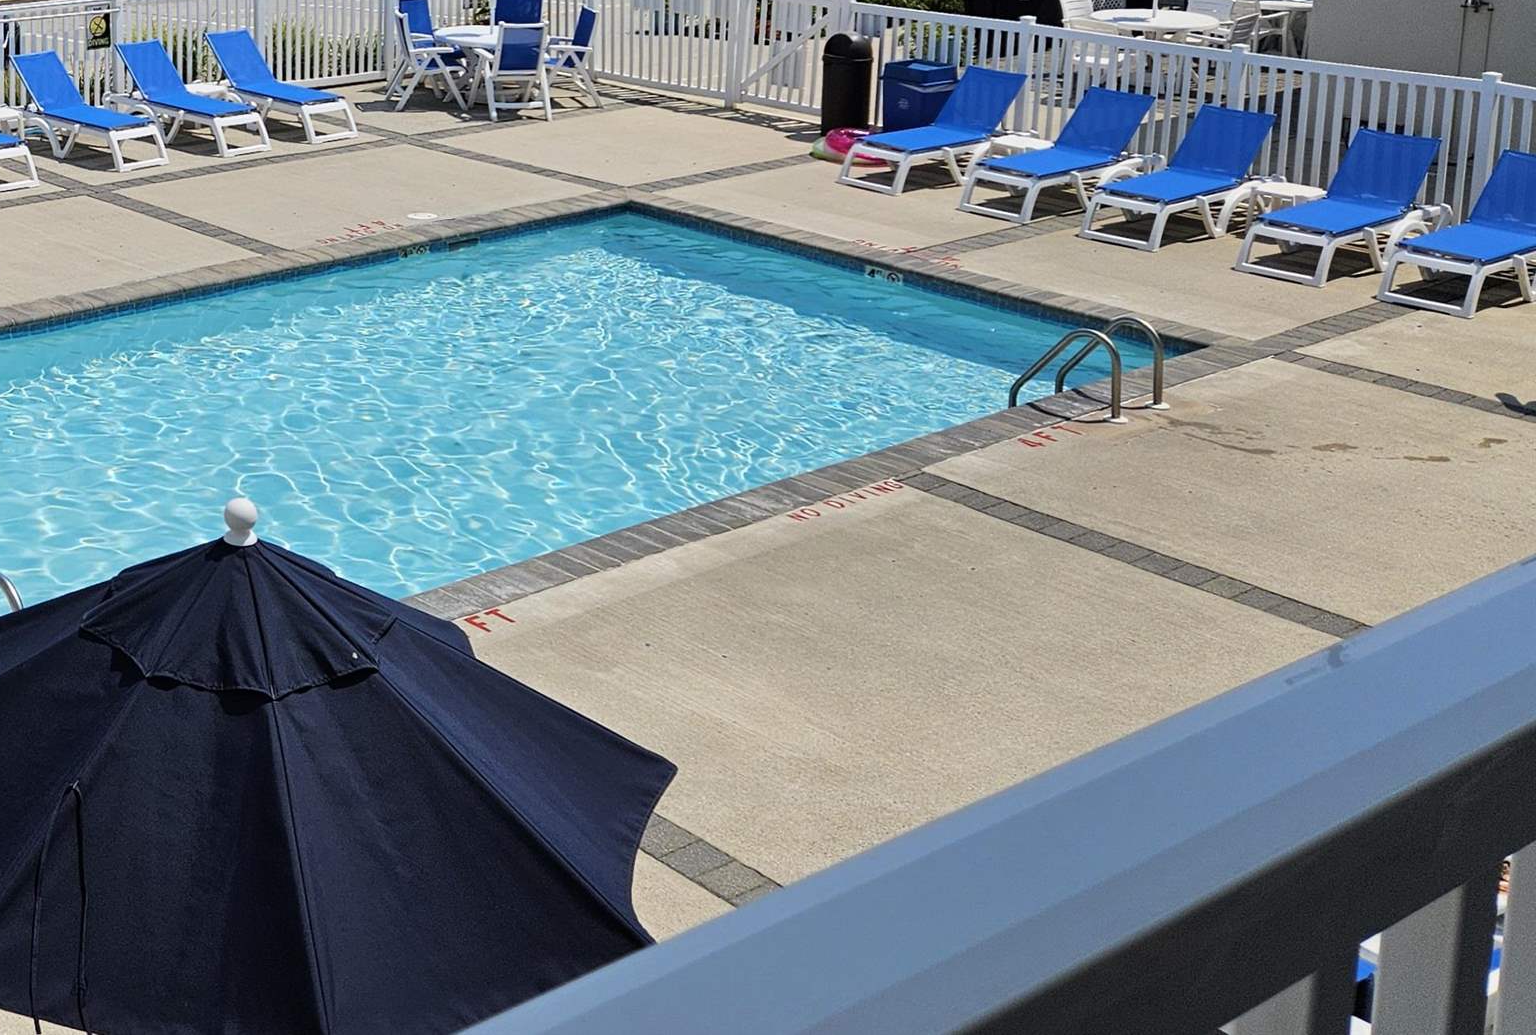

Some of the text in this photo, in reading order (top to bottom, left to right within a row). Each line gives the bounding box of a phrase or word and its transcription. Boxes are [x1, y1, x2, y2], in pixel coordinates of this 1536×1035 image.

[786, 479, 905, 522] NO DIVING
[463, 608, 516, 633] FT
